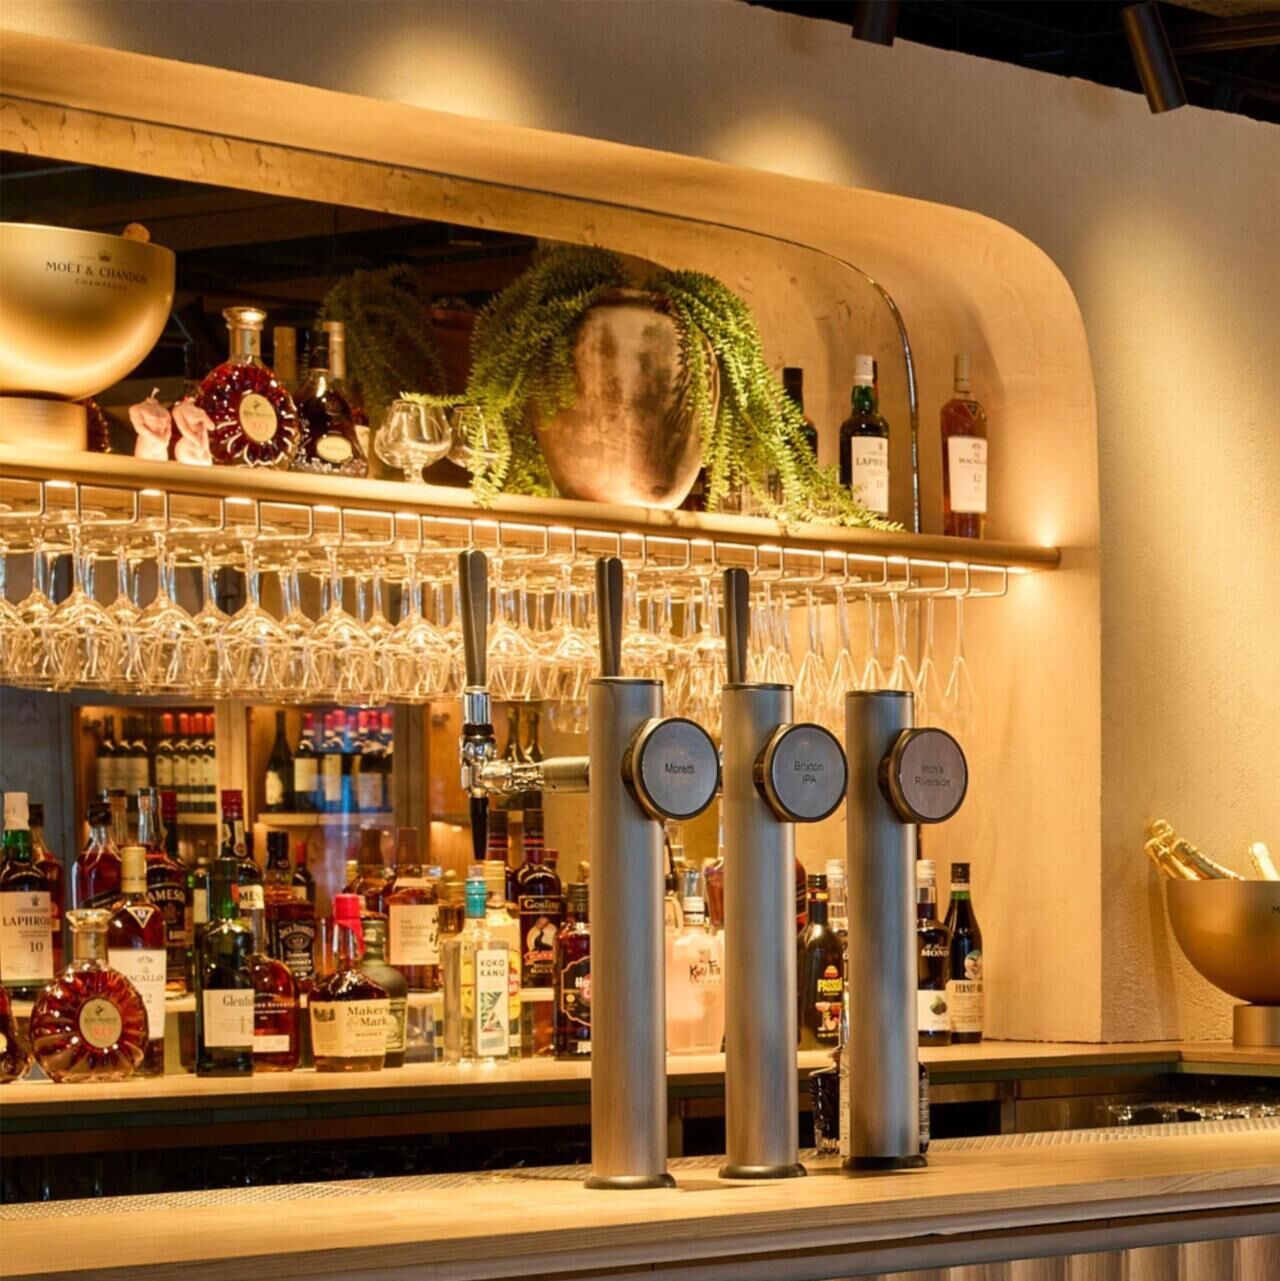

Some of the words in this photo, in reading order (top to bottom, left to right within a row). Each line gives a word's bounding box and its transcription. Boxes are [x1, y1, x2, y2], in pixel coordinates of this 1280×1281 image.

[85, 265, 94, 276] &
[665, 762, 695, 774] Moretti
[794, 760, 824, 771] Brixton
[802, 774, 817, 785] IPA
[914, 775, 950, 787] Riverside
[2, 915, 50, 927] LAPHRO
[30, 941, 43, 952] 10
[480, 959, 505, 967] KOKO
